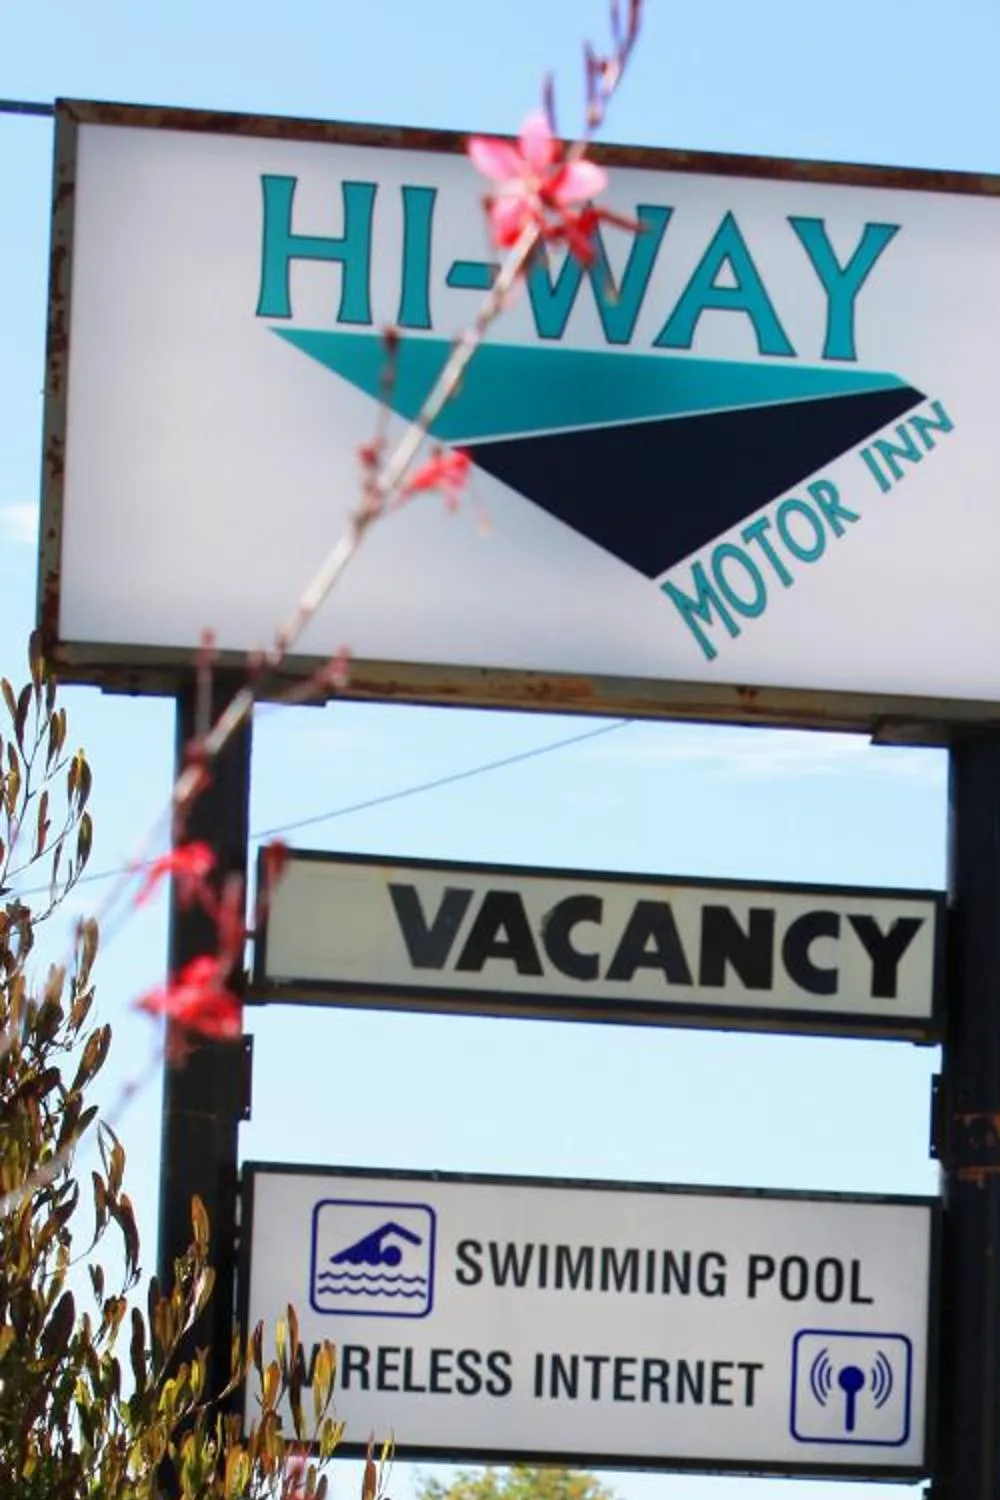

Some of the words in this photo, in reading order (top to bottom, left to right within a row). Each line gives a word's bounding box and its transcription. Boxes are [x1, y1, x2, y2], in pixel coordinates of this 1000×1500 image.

[256, 173, 902, 361] HI-WAY
[660, 479, 862, 662] MOTOR
[859, 400, 956, 494] INN
[388, 883, 926, 999] VACANCY
[455, 1239, 727, 1298] SWIMMING
[746, 1254, 875, 1305] POOL
[533, 1352, 765, 1408] INTERNET
